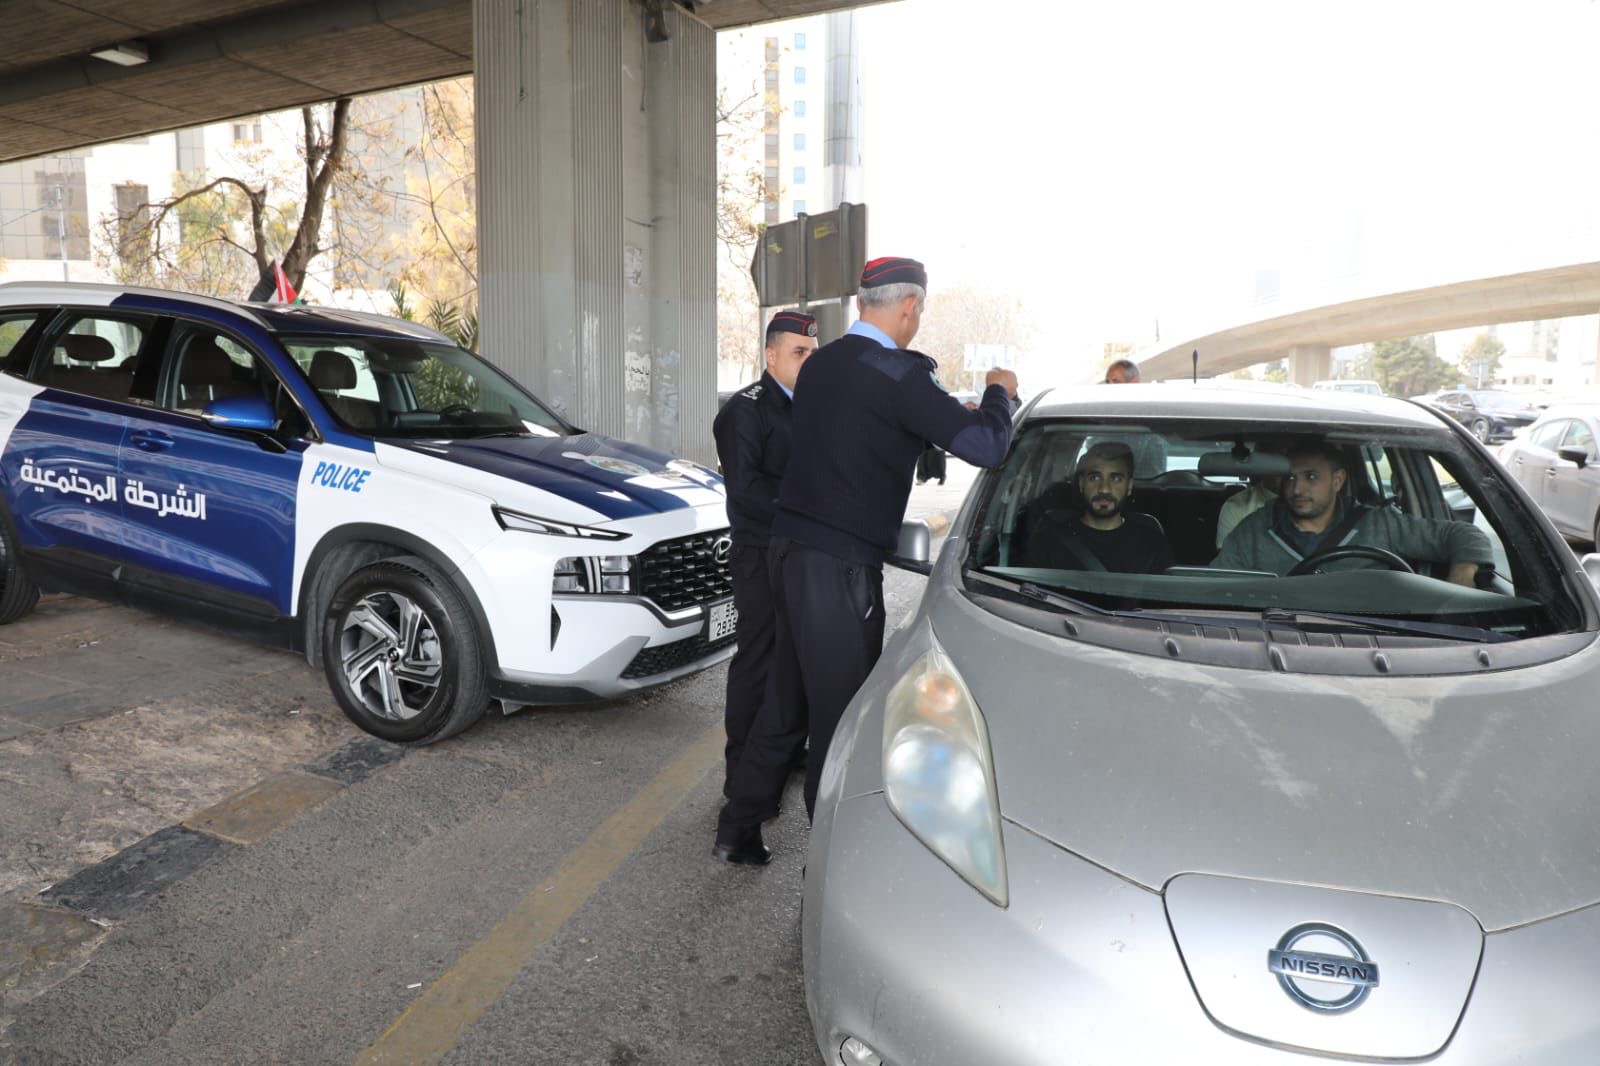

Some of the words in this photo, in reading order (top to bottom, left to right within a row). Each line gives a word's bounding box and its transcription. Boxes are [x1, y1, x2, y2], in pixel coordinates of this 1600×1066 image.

[20, 458, 118, 503] المجتمعية
[311, 461, 371, 493] POLICE
[124, 479, 206, 520] الشرطة
[1281, 956, 1369, 981] NISSAN
